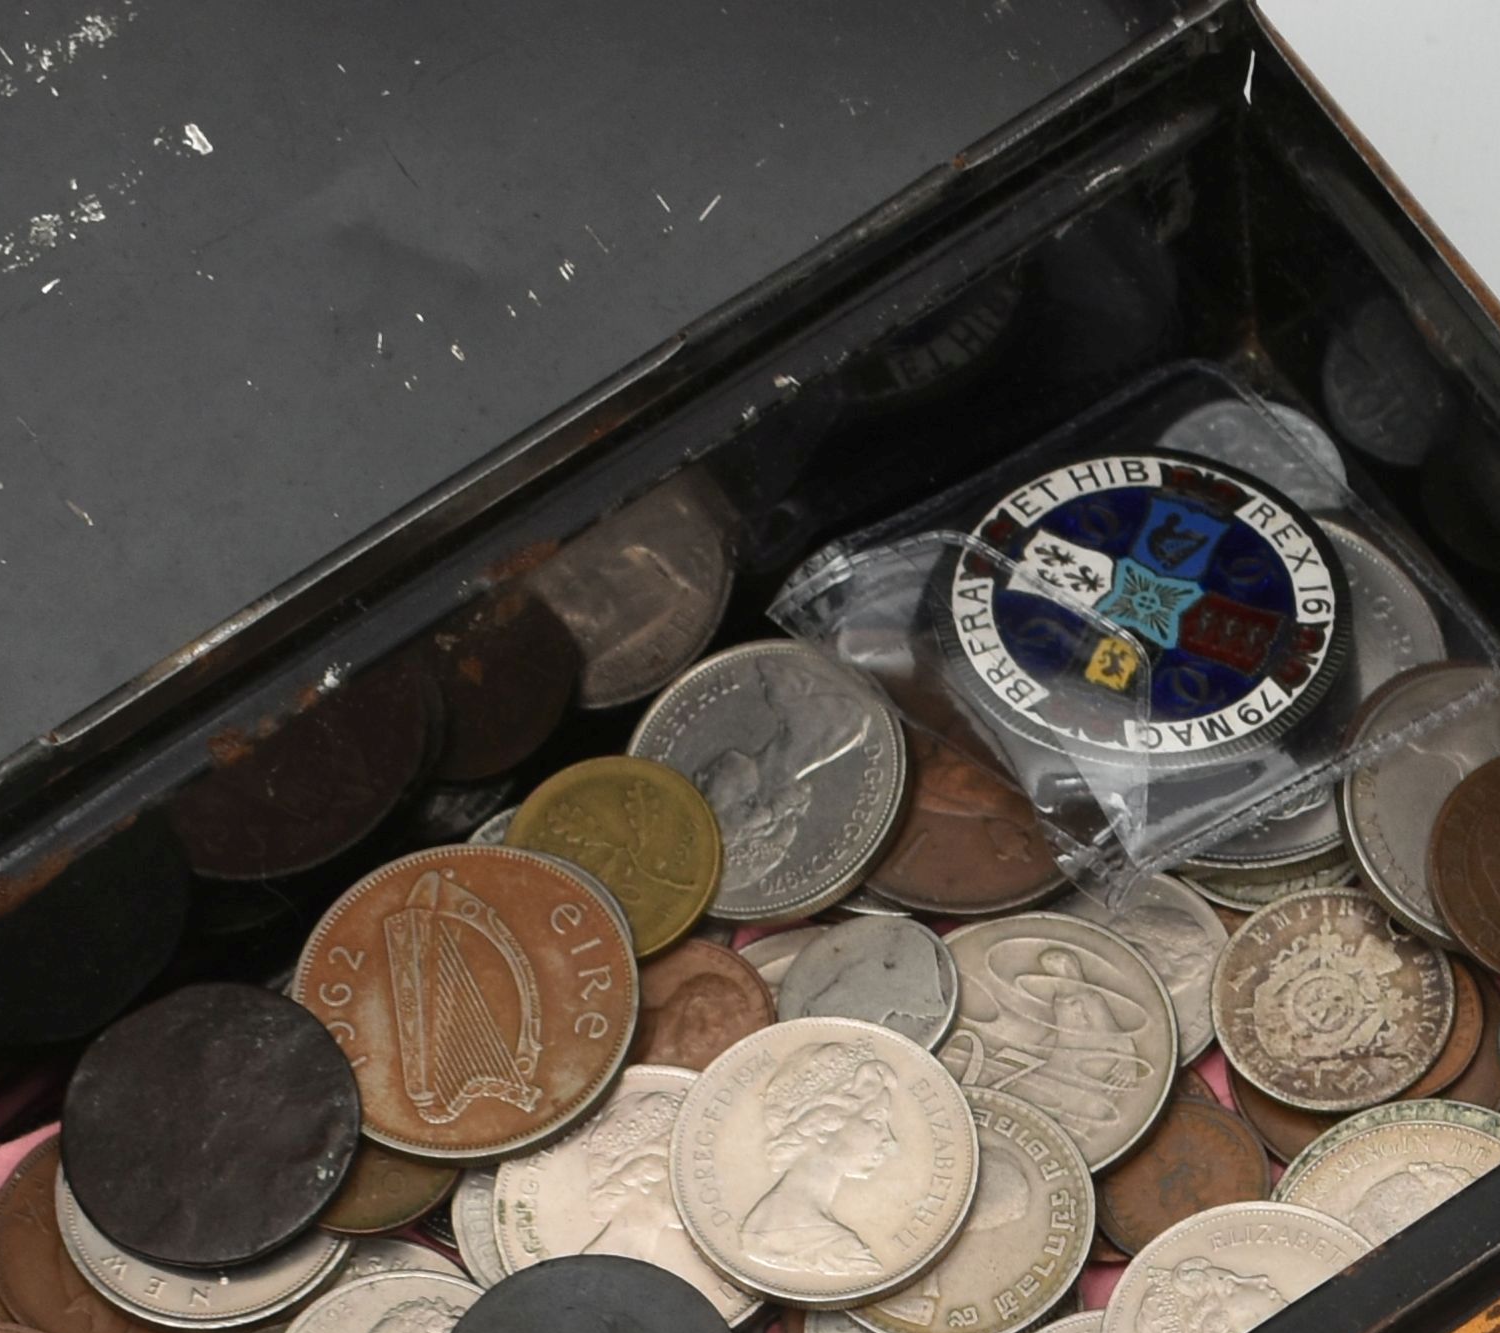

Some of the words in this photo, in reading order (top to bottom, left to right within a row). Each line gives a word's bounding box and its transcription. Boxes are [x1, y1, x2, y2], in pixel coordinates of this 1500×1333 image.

[1071, 459, 1150, 492] HIB
[1008, 480, 1061, 520] ET
[1254, 501, 1319, 574] REX
[1237, 690, 1283, 726] 79
